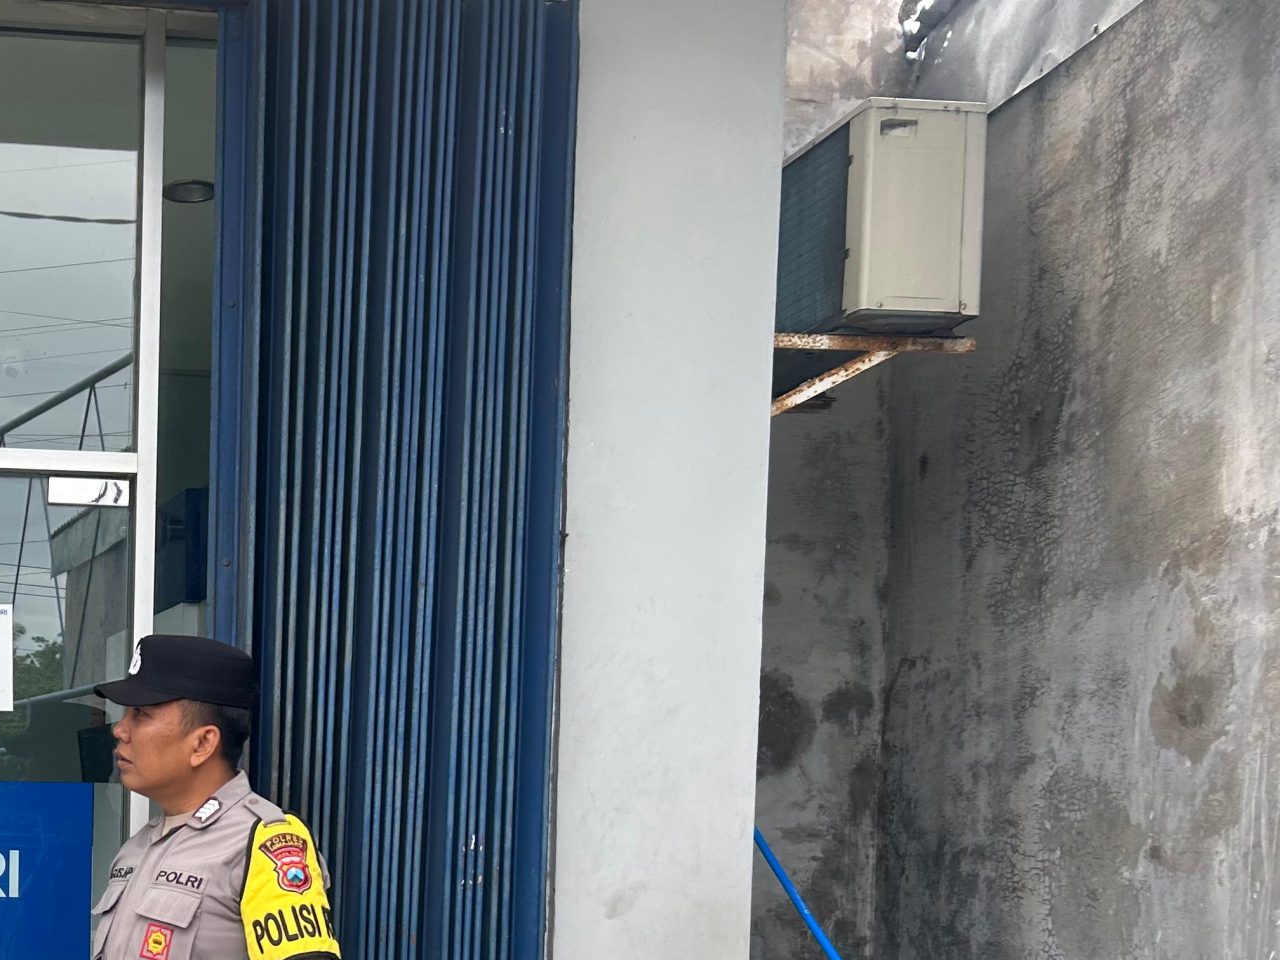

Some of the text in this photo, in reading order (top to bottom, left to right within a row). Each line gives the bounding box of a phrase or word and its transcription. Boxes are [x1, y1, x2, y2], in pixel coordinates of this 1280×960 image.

[265, 834, 304, 847] POLRES
[155, 870, 204, 890] POLRI
[252, 903, 322, 954] POLISI
